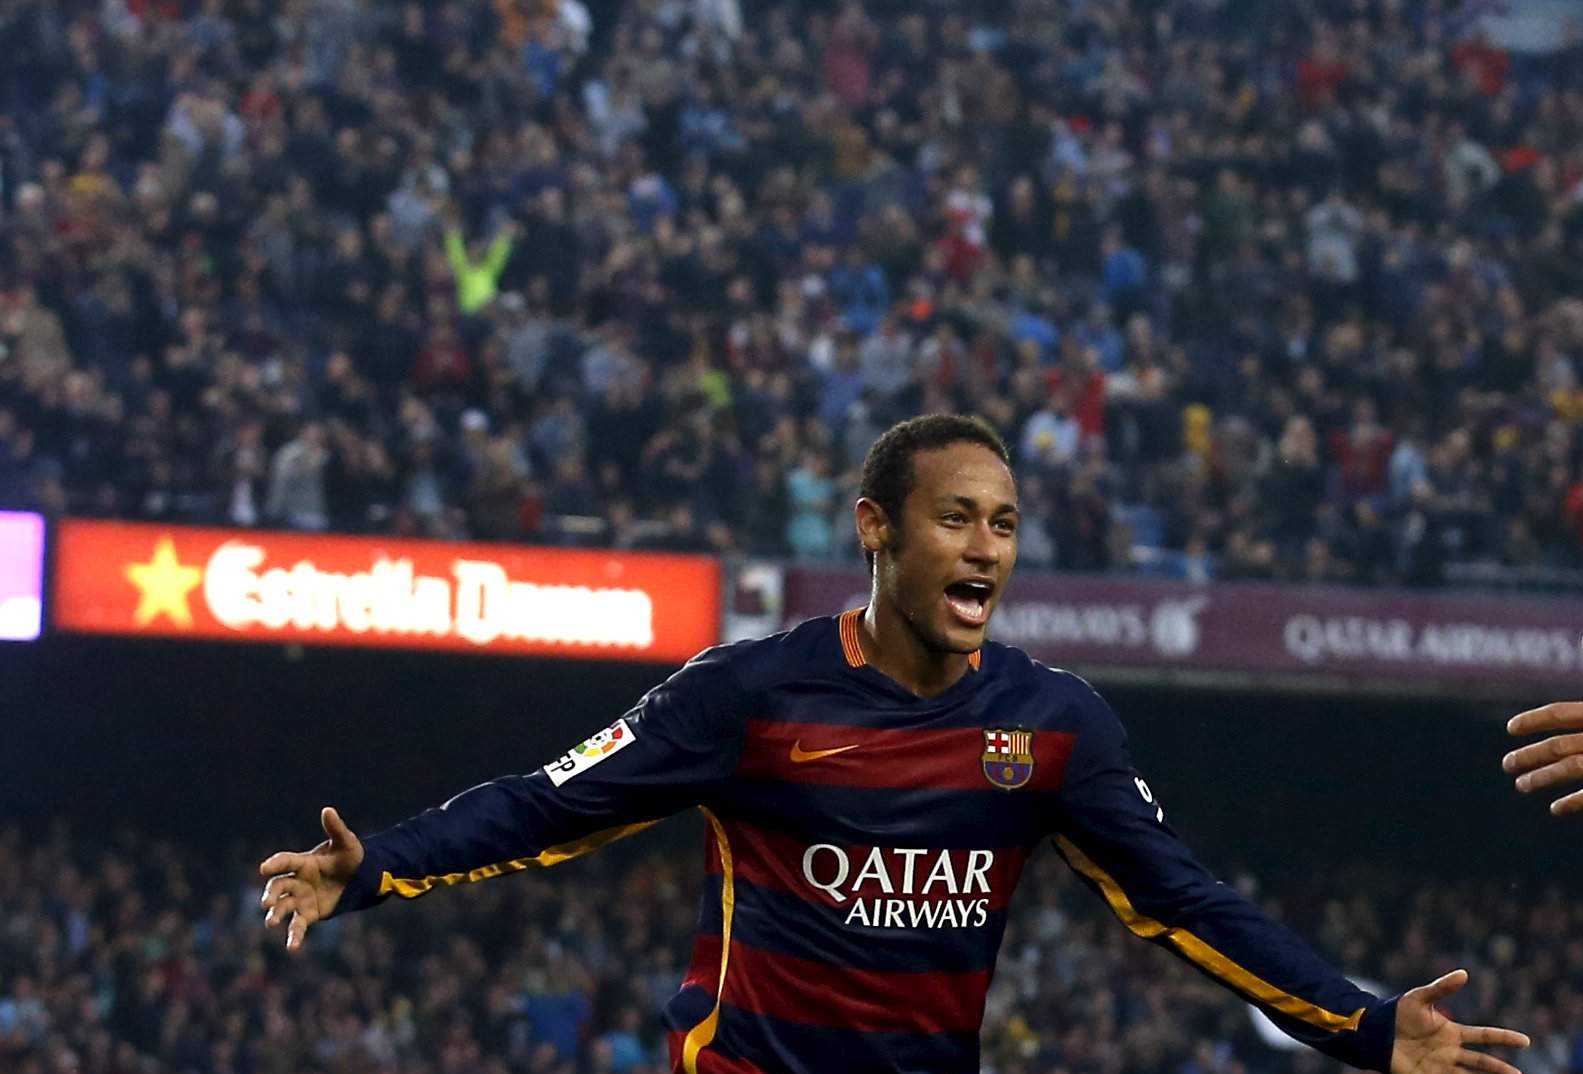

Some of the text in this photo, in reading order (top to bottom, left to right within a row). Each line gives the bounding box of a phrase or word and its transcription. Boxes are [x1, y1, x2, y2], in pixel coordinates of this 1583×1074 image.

[1283, 614, 1413, 666] QATAR
[802, 844, 994, 902] QATAR
[844, 897, 989, 929] AIRWAYS
